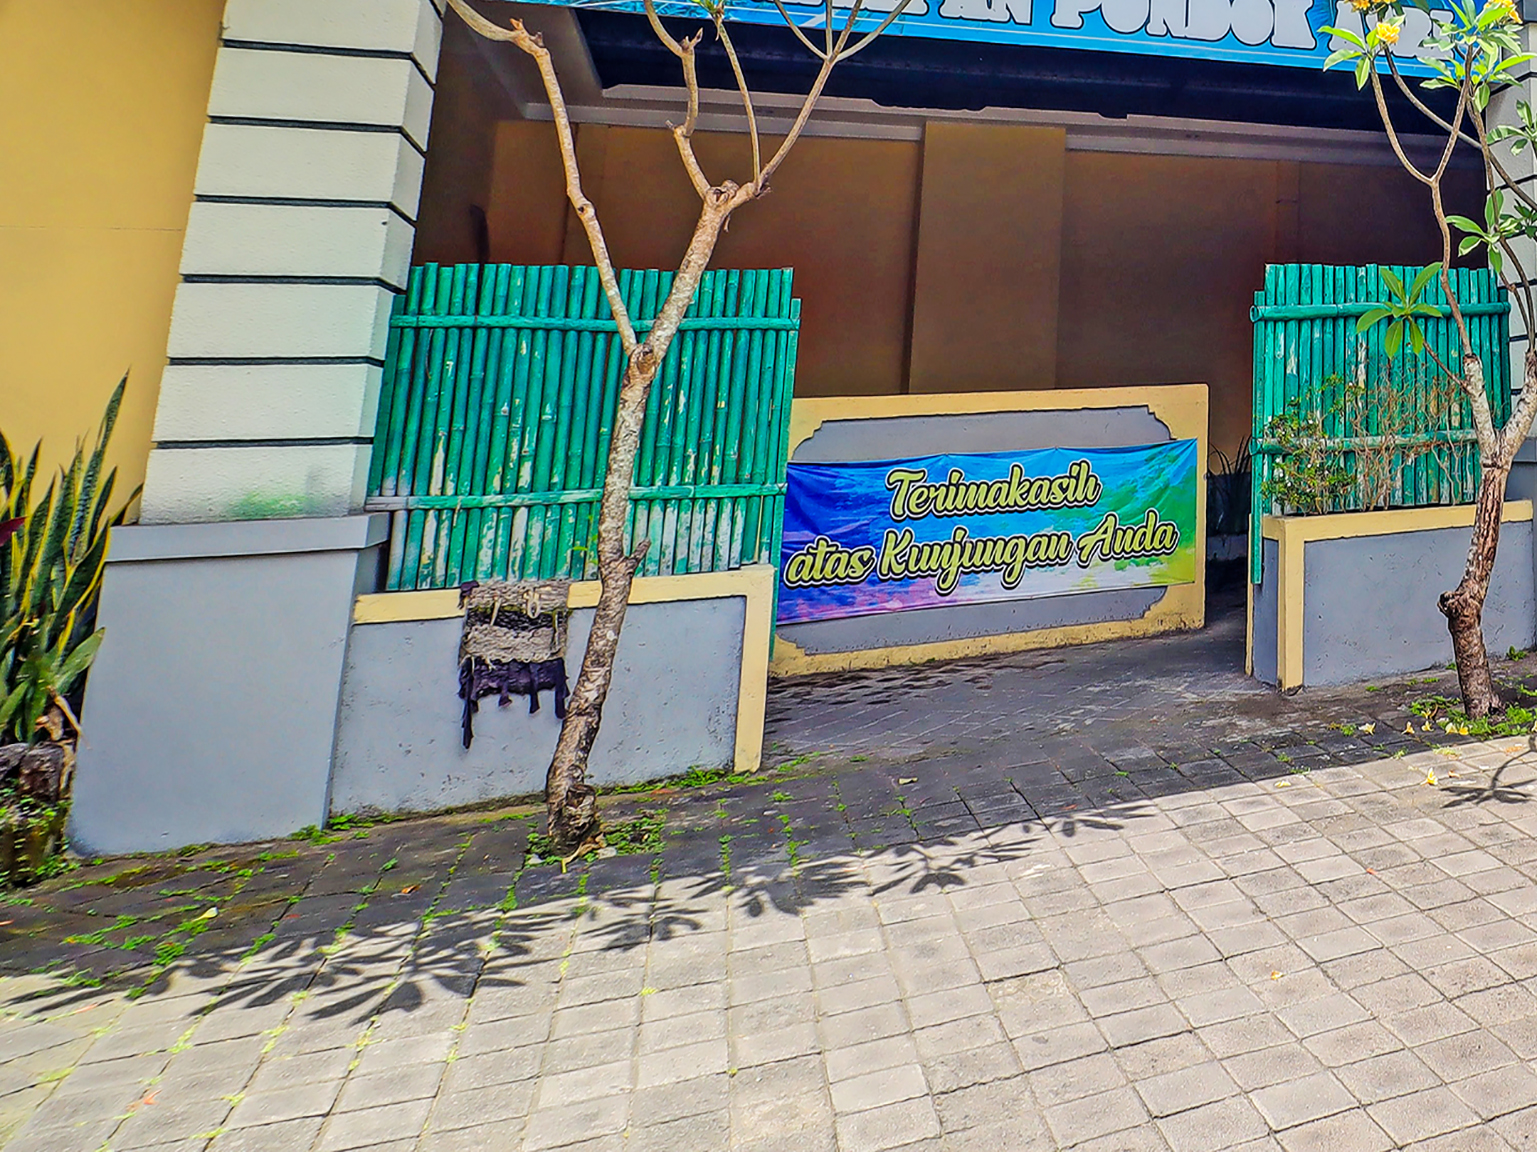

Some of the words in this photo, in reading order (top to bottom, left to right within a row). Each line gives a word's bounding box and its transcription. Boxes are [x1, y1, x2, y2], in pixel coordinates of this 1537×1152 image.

[886, 459, 1101, 519] Terimakasih
[784, 536, 875, 589] atas
[879, 526, 1072, 595] Kunjungan
[1077, 509, 1179, 568] Anda
